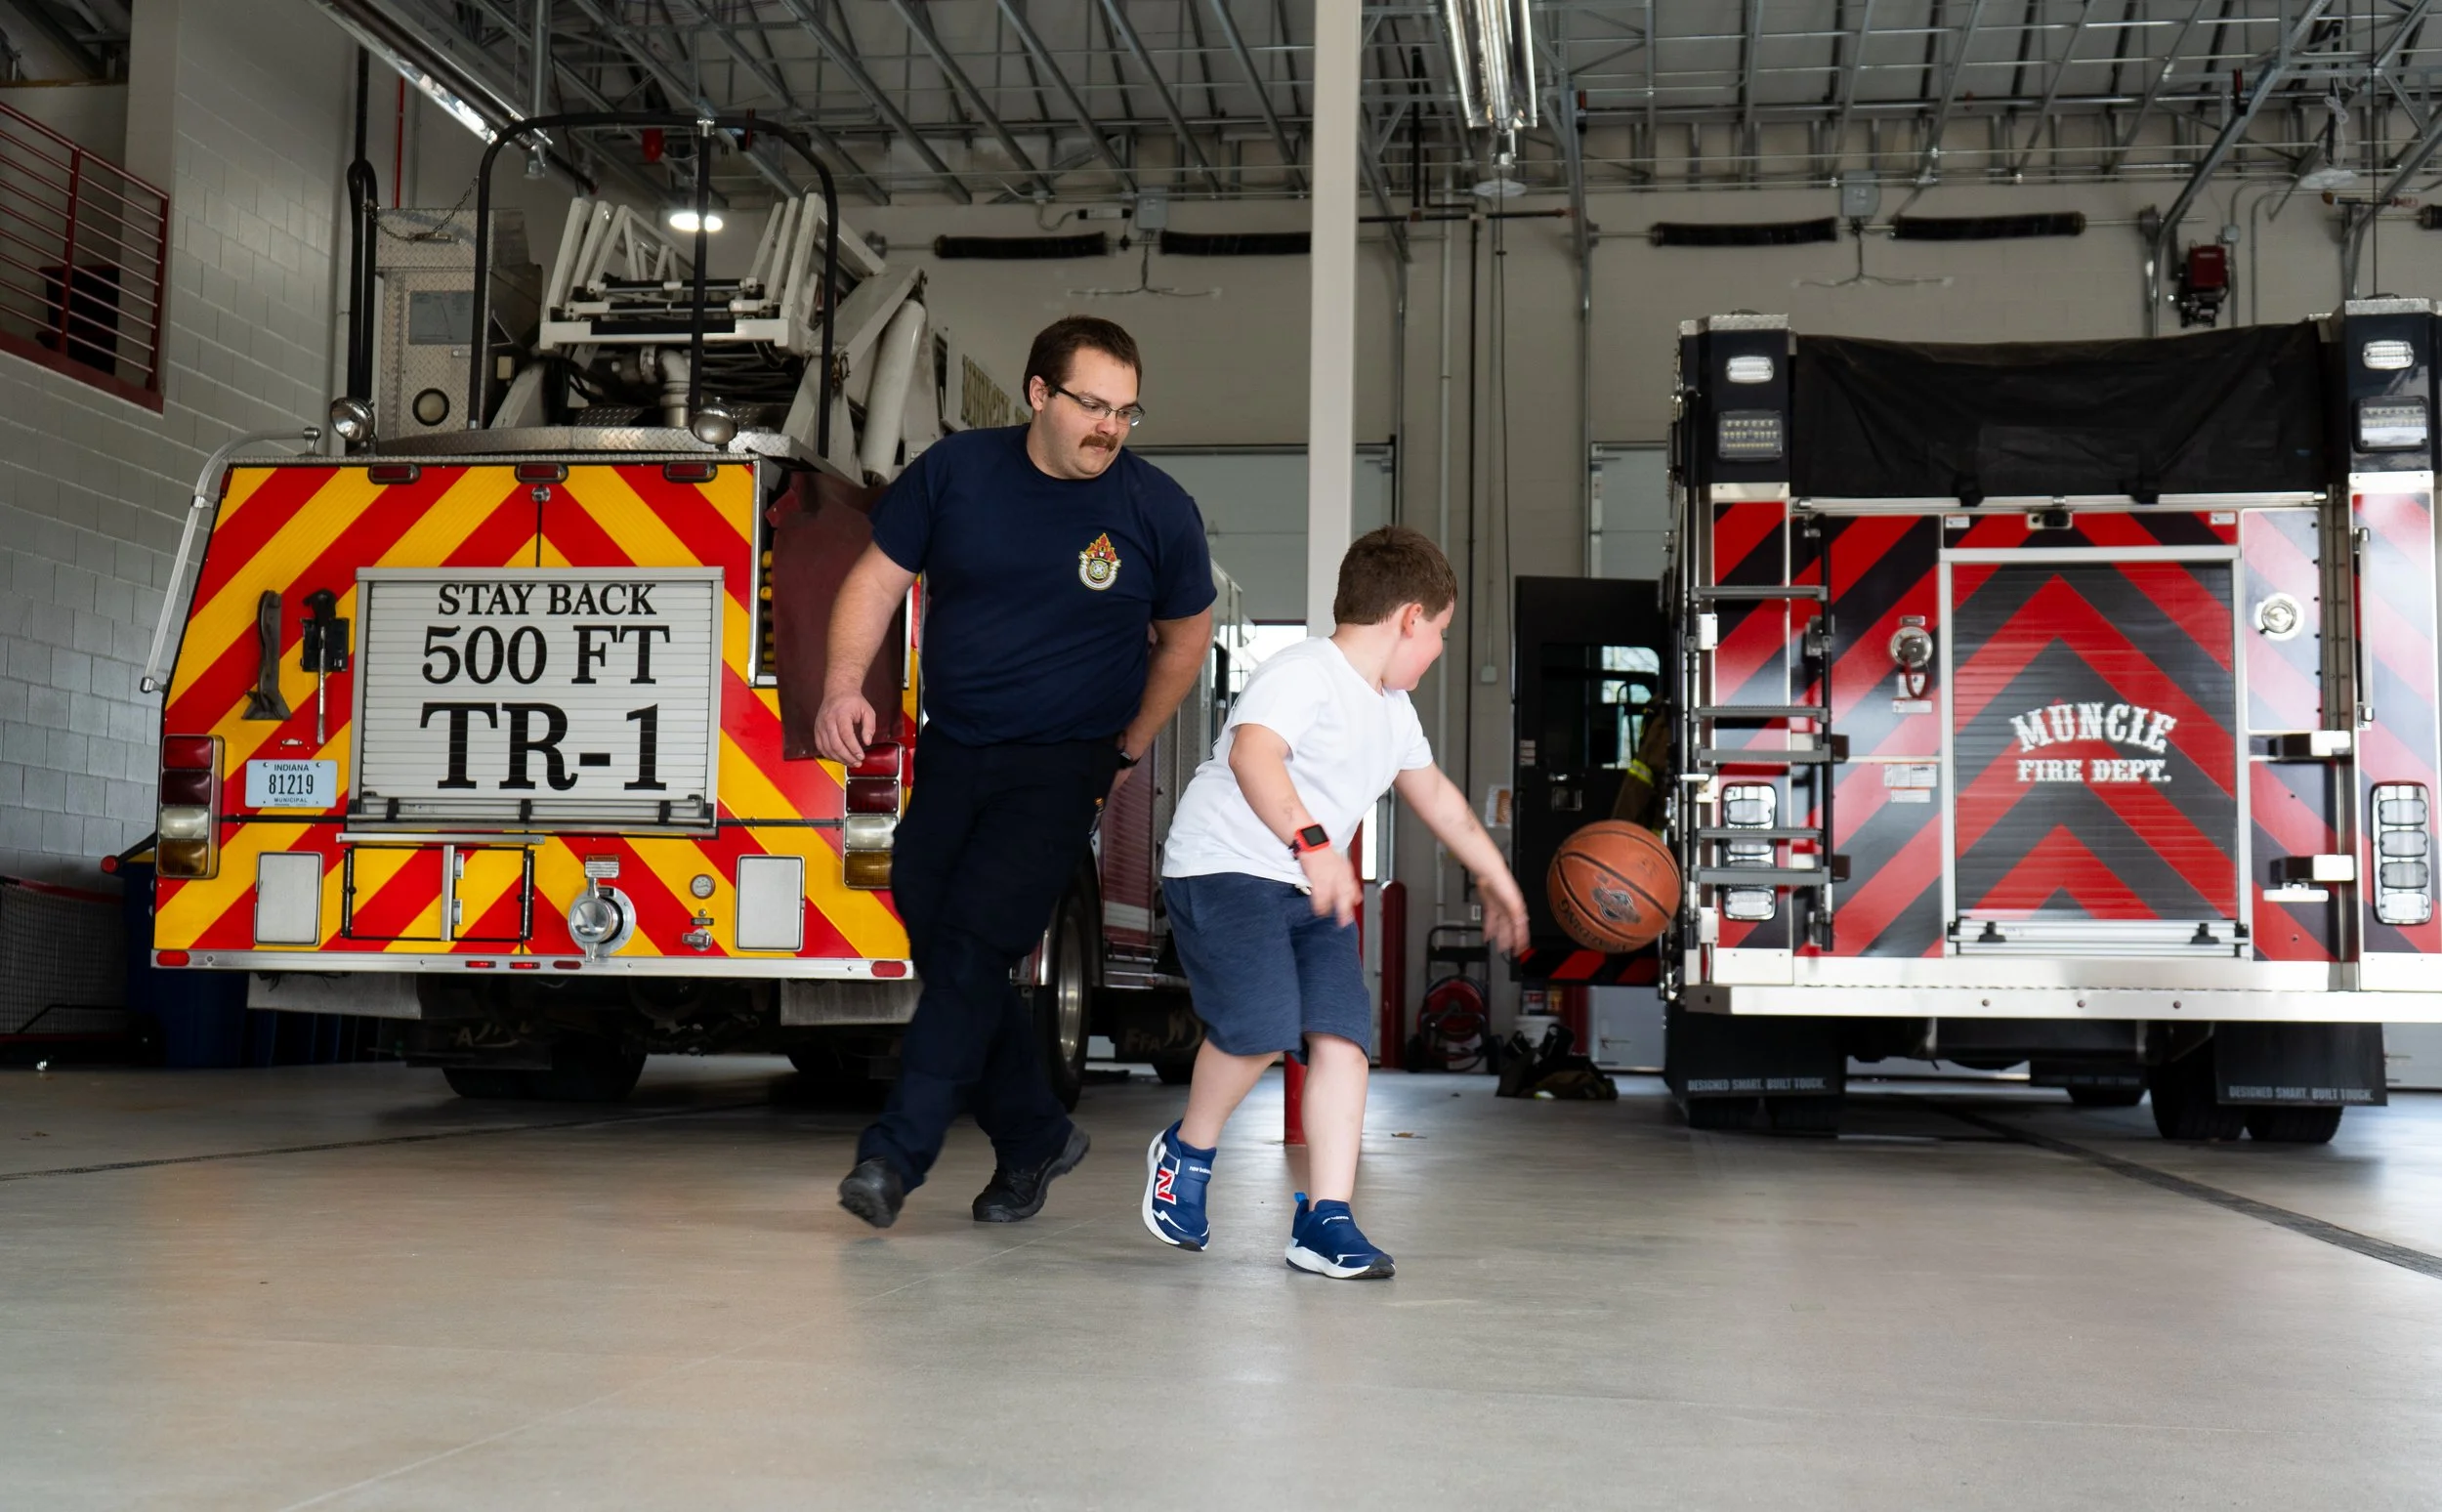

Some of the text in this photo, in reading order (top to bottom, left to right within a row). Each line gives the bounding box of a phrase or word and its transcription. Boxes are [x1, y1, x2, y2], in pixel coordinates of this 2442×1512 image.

[439, 582, 657, 615] STAY BACK
[422, 624, 671, 685] 500 FT
[2009, 701, 2177, 754] MUNCIE
[419, 701, 667, 791] TR-1
[2017, 758, 2171, 782] FIRE DEPT.
[269, 774, 315, 795] 81219
[1688, 1078, 1730, 1091] DESIGNED
[1766, 1077, 1791, 1090] BUILT
[2229, 1085, 2273, 1099] DESIGNED
[2311, 1087, 2337, 1100] BUILT
